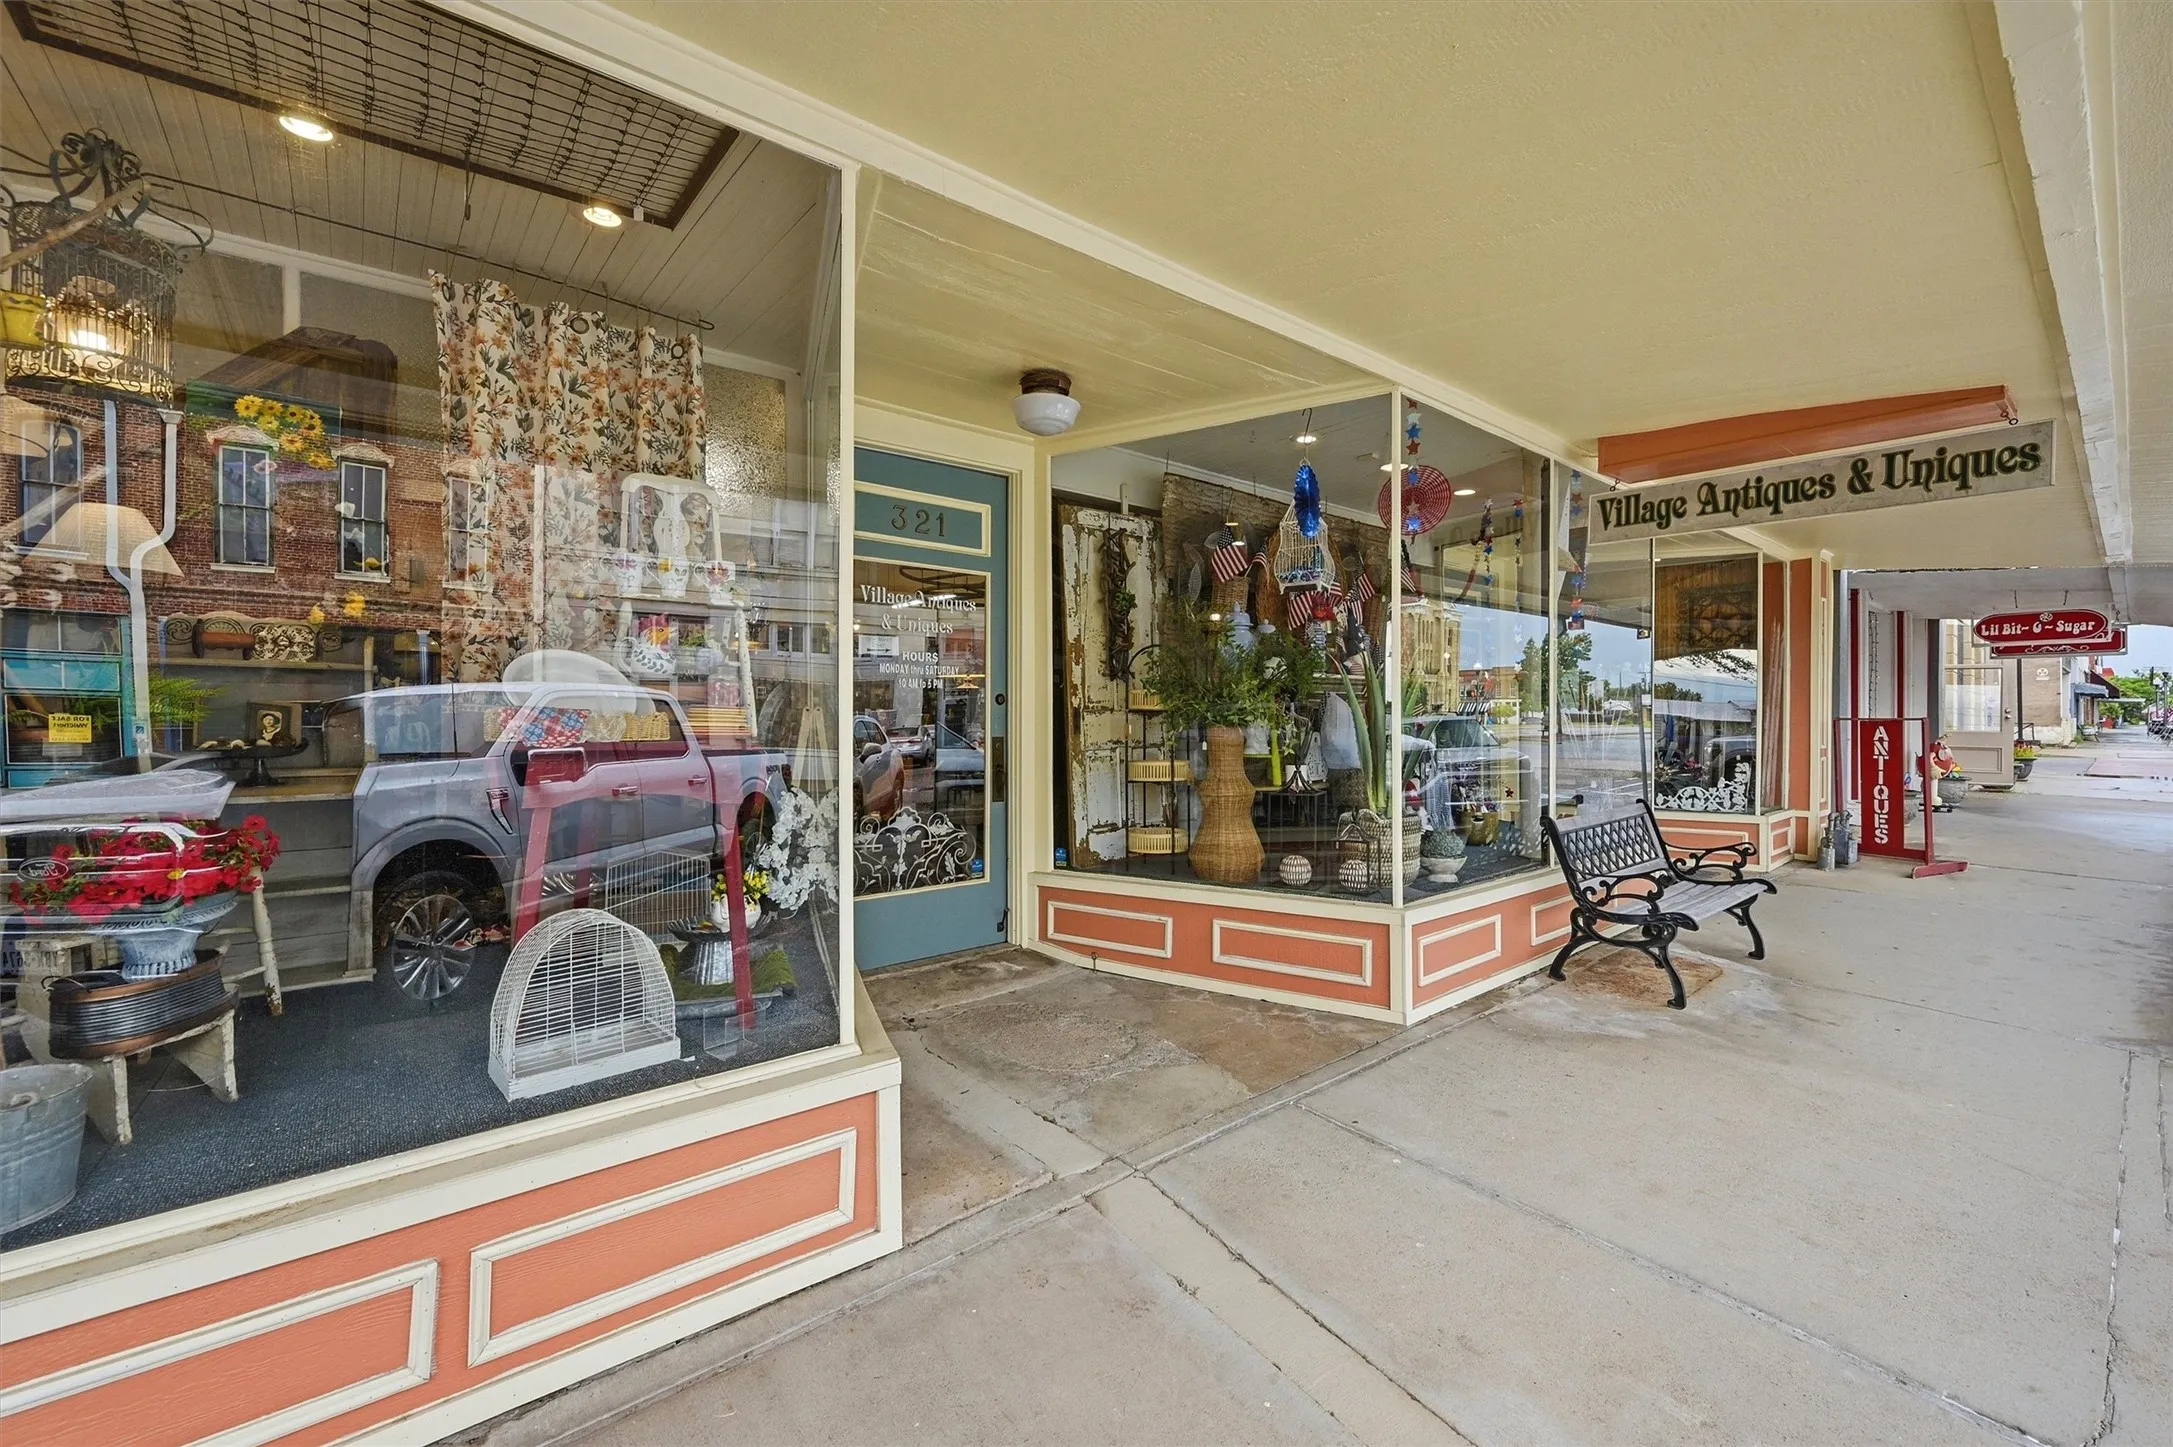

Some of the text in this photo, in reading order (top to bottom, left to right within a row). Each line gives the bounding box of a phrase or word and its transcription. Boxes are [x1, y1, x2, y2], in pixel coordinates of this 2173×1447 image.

[1597, 442, 2042, 531] Village Antiques & Uniques
[891, 504, 945, 537] 321
[860, 585, 977, 613] Village Antiques
[881, 613, 953, 637] & Uniques
[1981, 624, 1999, 636] Lil
[2055, 620, 2096, 635] Sugar
[902, 651, 939, 662] HOURS
[880, 662, 960, 676] MONDAY thru SATURDAY
[898, 677, 907, 688] 10
[908, 678, 919, 688] AM
[927, 678, 932, 689] 5
[932, 678, 943, 689] PM
[1873, 725, 1889, 844] ANTIQUES
